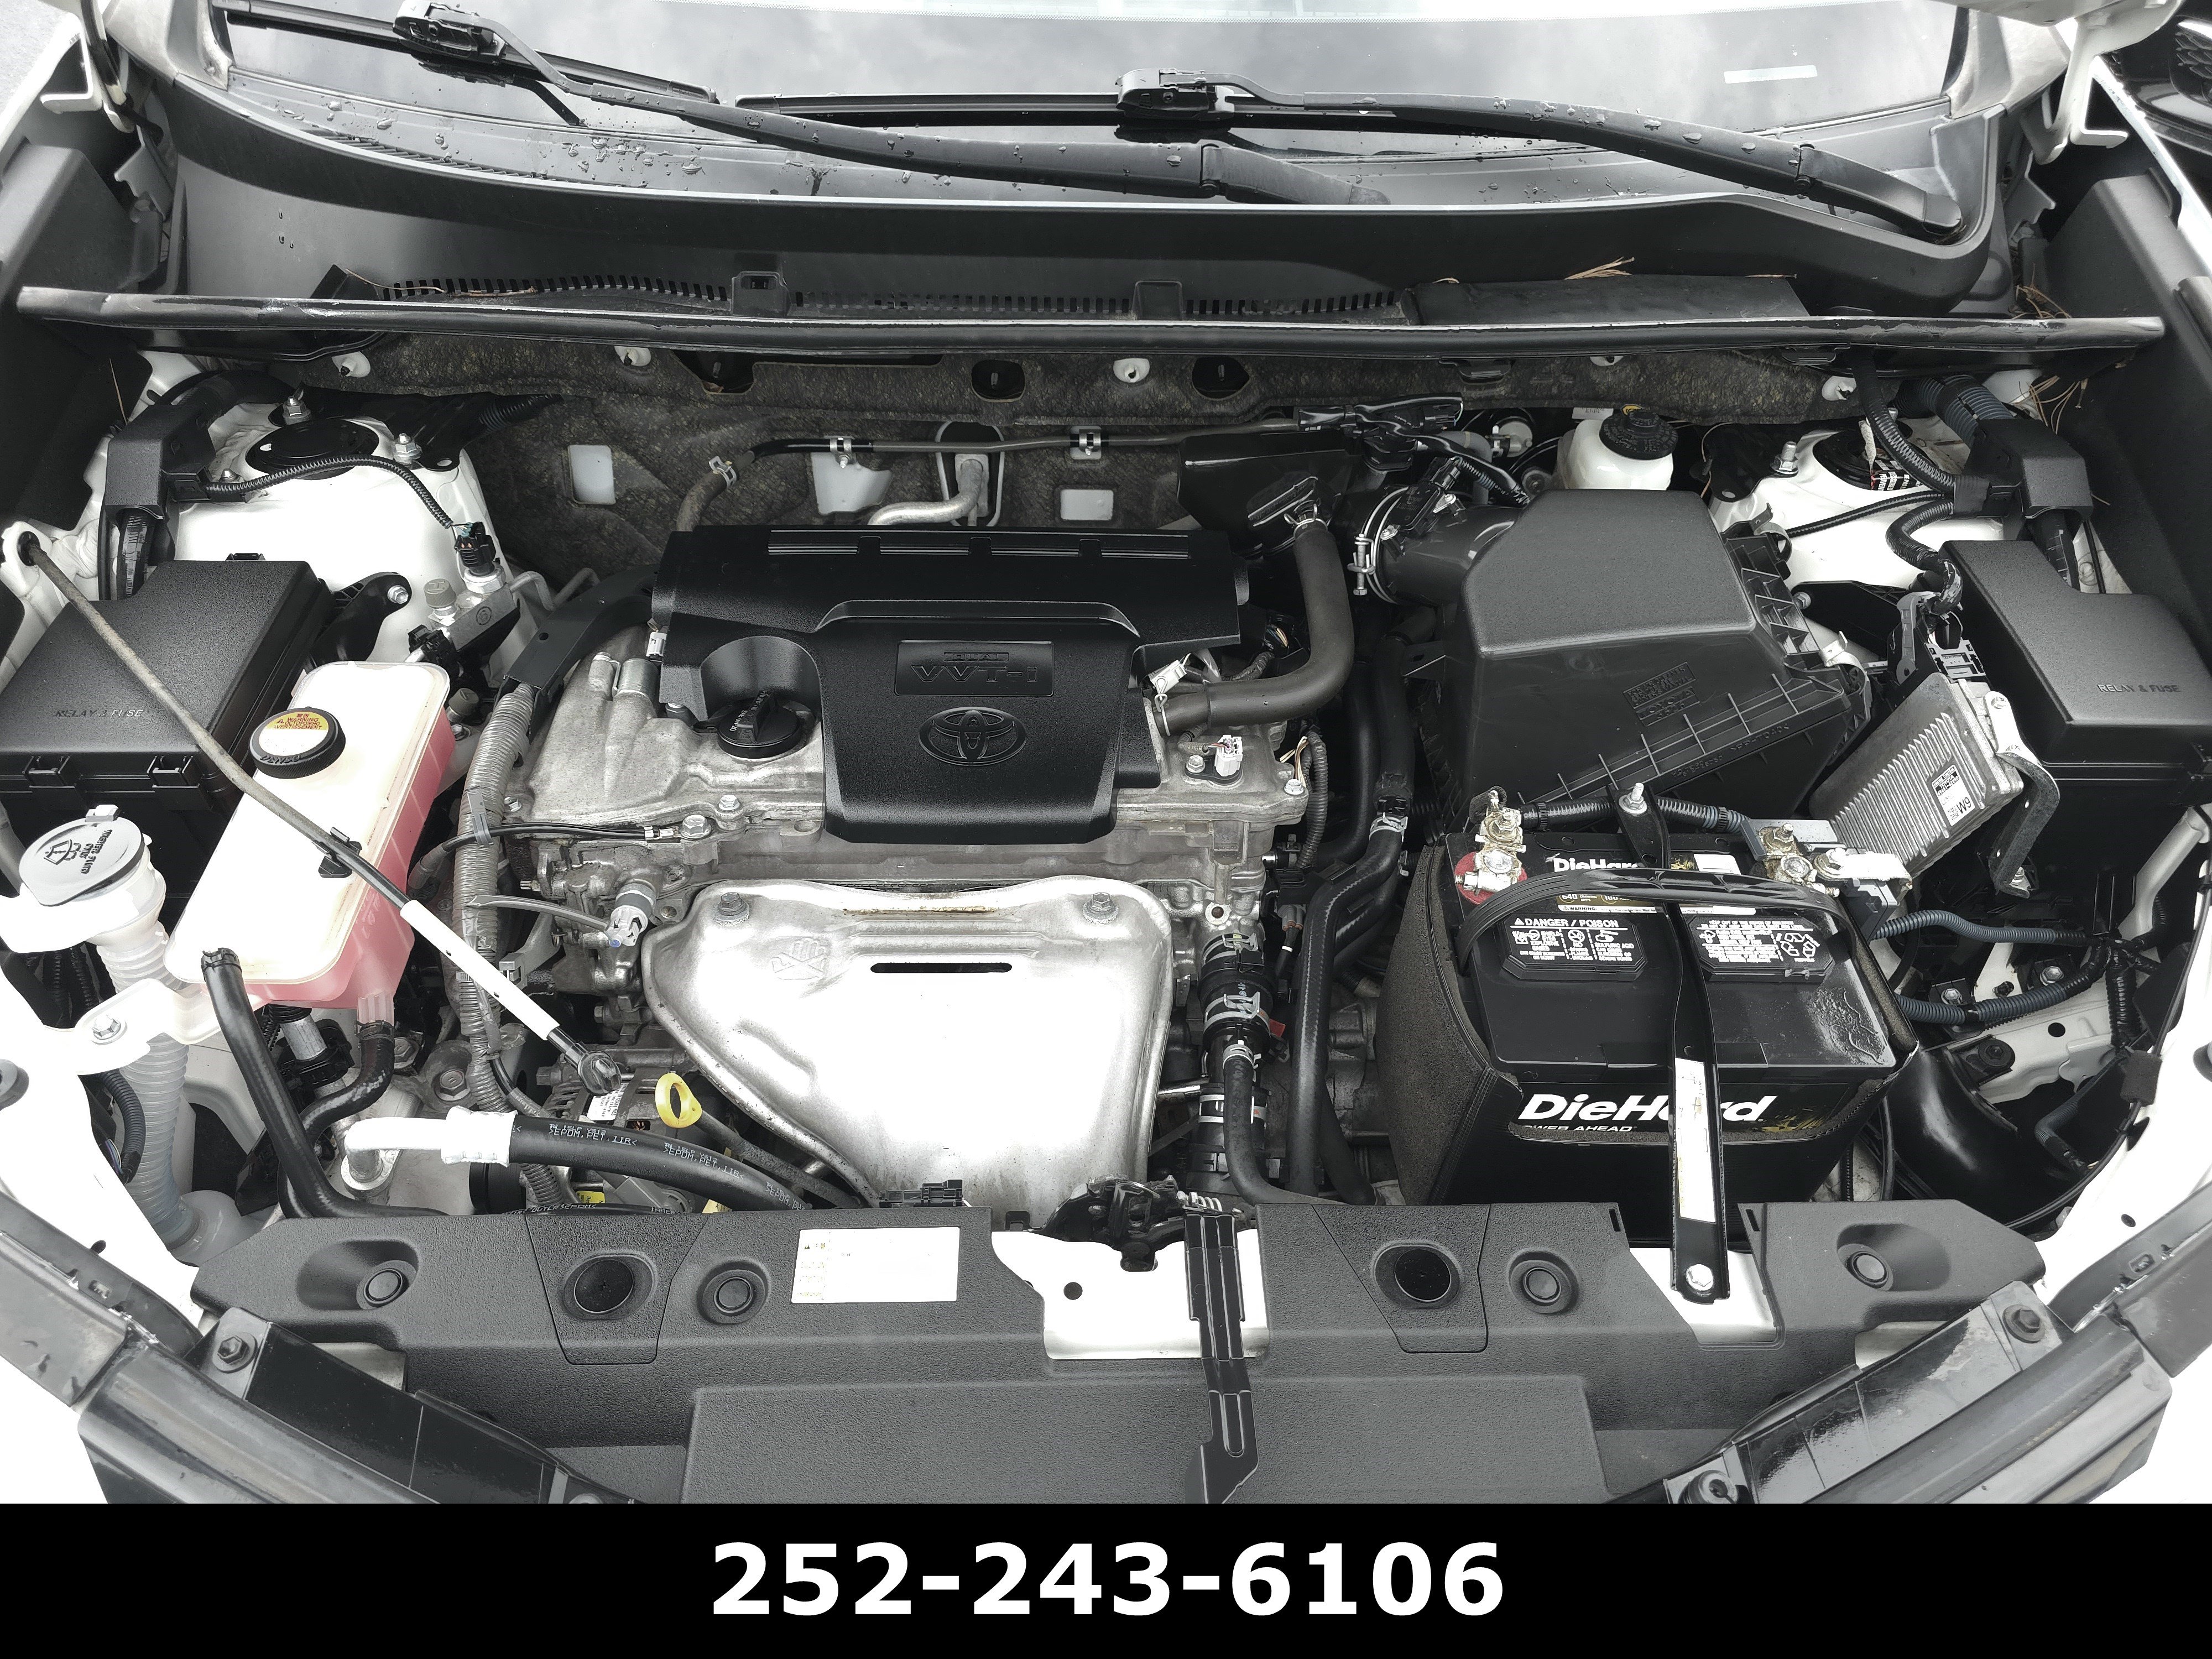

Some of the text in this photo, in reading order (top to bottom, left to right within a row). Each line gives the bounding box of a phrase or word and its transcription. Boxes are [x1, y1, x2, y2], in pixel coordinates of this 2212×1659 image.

[952, 653, 1001, 661] DUAL
[911, 665, 1038, 682] VVT-i
[2098, 684, 2135, 692] RELAY
[260, 754, 301, 764] DENSO
[1940, 774, 1955, 789] TOYOTA
[1956, 797, 1971, 814] W9
[81, 829, 112, 874] WASHER FLUID
[1553, 857, 1645, 872] DieHar
[1525, 918, 1569, 926] DANGER
